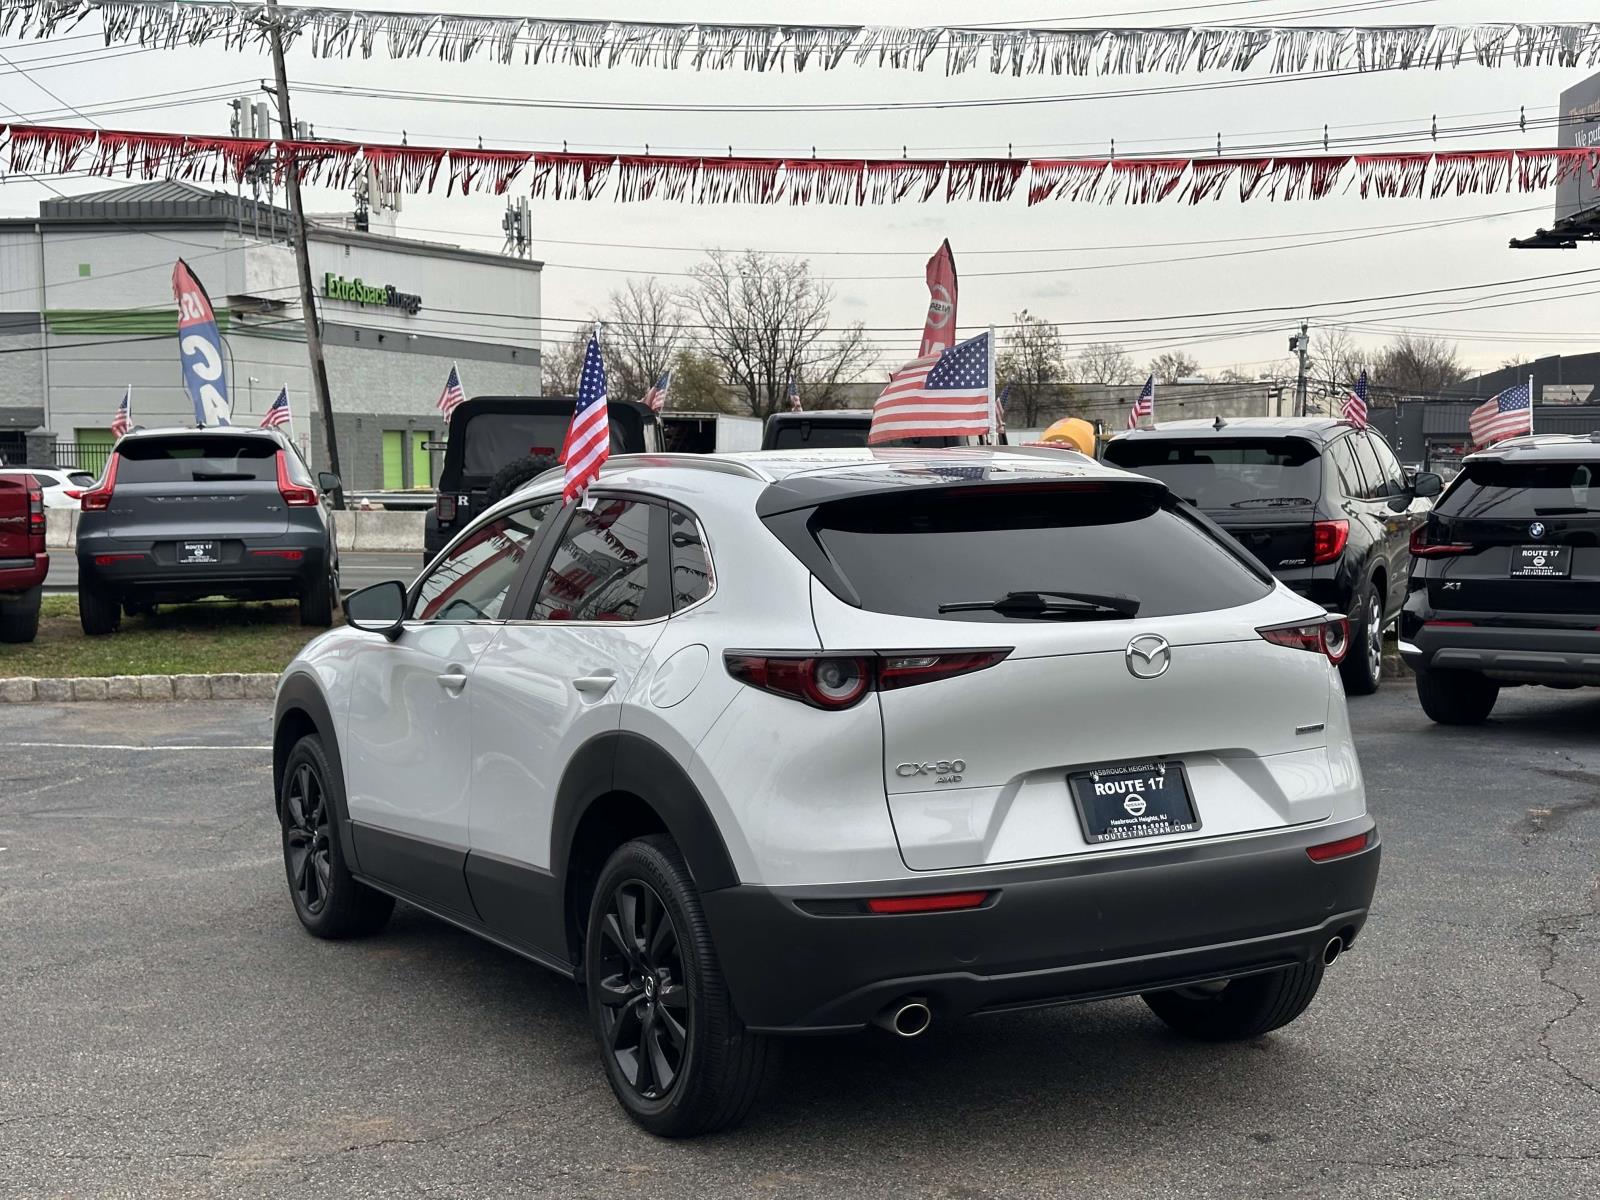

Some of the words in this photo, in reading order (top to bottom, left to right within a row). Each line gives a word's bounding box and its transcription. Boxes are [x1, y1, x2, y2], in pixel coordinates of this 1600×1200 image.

[1575, 130, 1586, 147] We
[458, 495, 469, 506] R
[1442, 582, 1461, 590] X1
[896, 758, 966, 777] CX-30
[1089, 767, 1128, 777] HASBROUCK
[1128, 763, 1154, 773] HEIGHTS
[935, 775, 962, 784] AWD
[1094, 779, 1145, 796] ROUTE
[1148, 777, 1164, 790] 17
